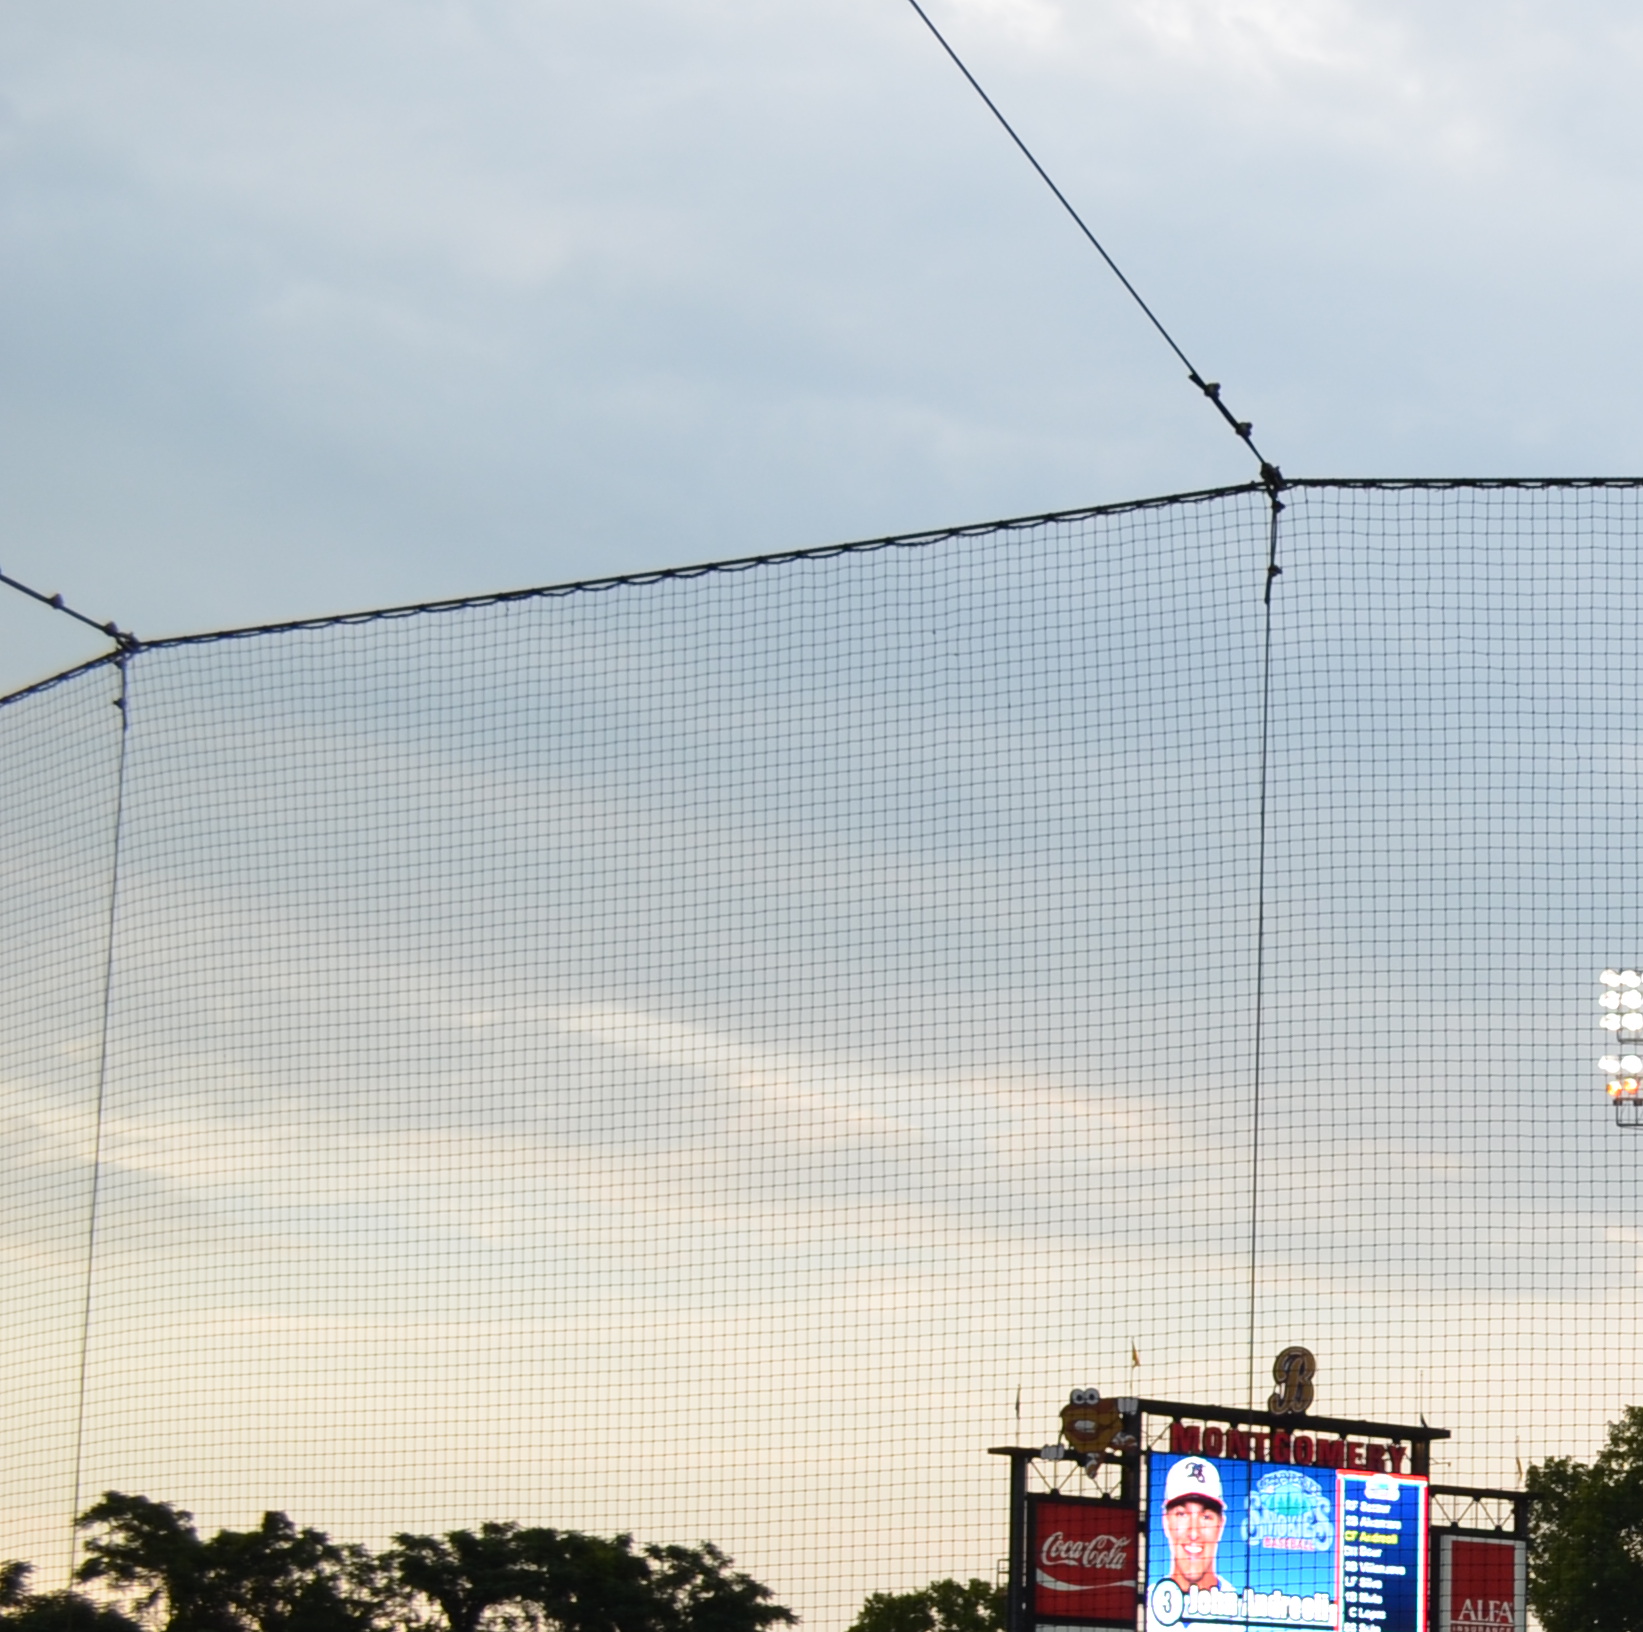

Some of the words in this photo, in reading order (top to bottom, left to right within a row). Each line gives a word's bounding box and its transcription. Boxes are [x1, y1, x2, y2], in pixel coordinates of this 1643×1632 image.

[1171, 1423, 1407, 1472] MONTGOMERY
[1041, 1531, 1131, 1569] Coca-Cola
[1162, 1590, 1174, 1613] 3
[1186, 1584, 1239, 1617] John
[1241, 1588, 1330, 1621] Andreoli
[1458, 1599, 1514, 1624] ALFA
